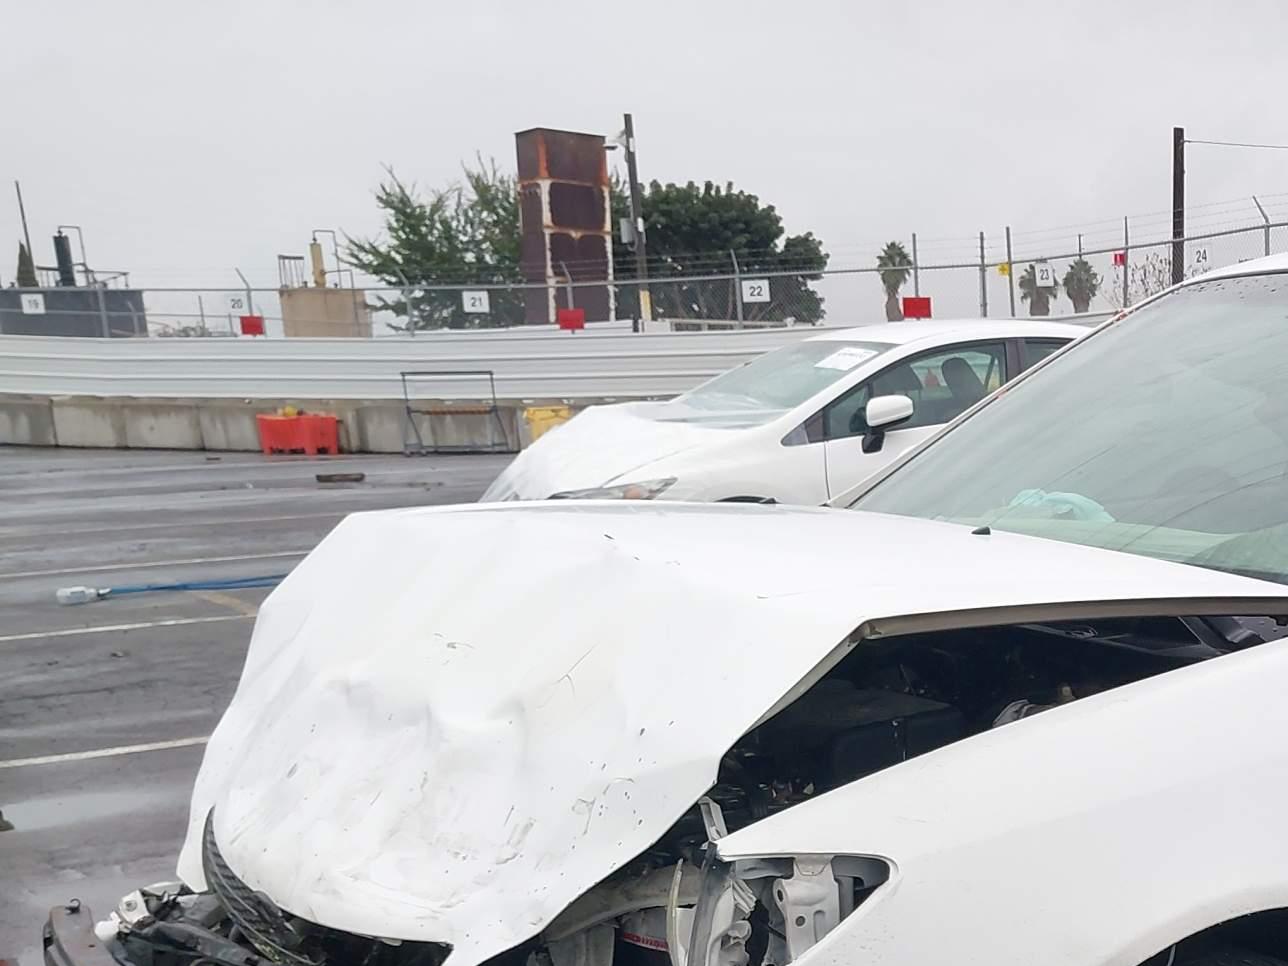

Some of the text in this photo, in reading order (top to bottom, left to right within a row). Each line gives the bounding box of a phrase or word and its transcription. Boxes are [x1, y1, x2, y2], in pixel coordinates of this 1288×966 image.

[1195, 248, 1207, 263] 24
[1039, 268, 1050, 281] 23
[749, 285, 763, 297] 22
[230, 298, 243, 309] 20
[470, 296, 483, 307] 21
